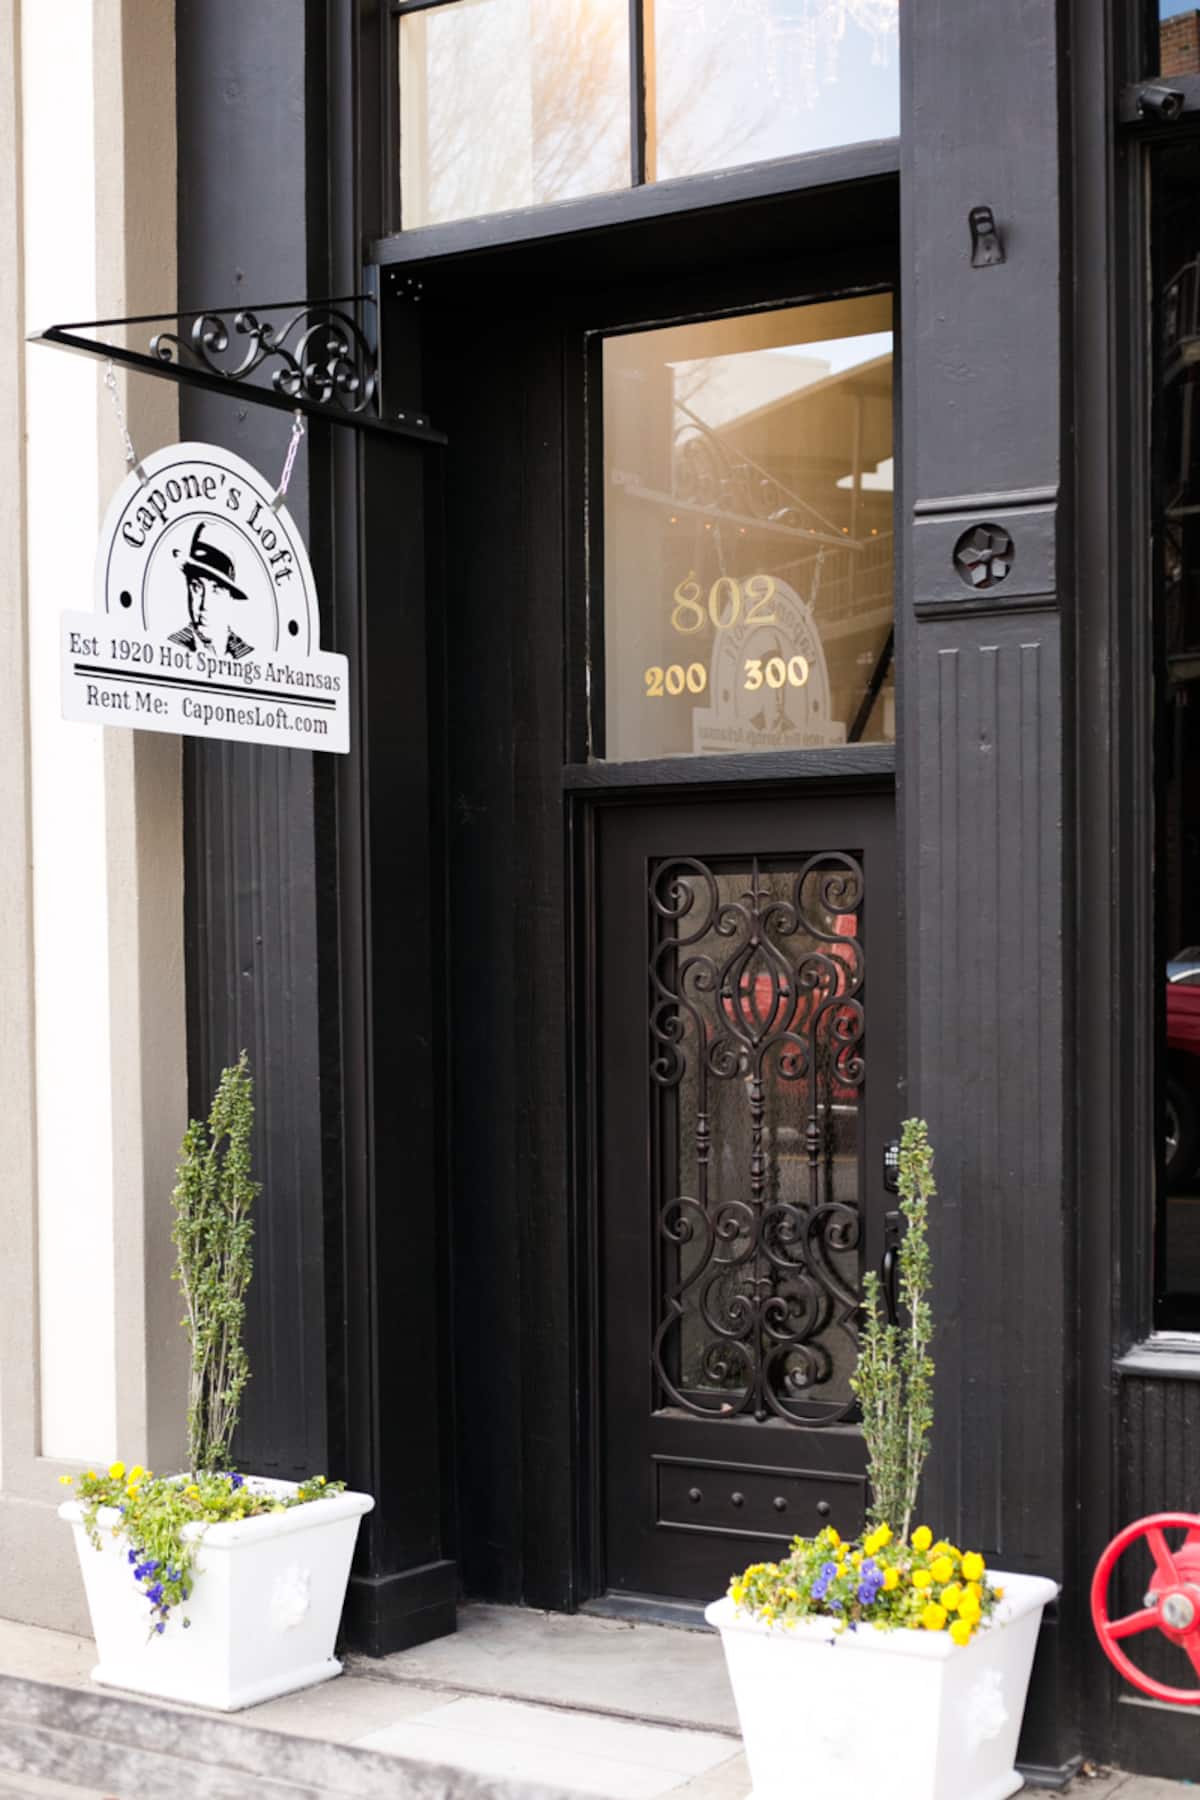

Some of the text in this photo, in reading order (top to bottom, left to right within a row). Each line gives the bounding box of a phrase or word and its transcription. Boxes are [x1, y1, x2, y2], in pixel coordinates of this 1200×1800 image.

[122, 473, 293, 587] Capone's Loft
[671, 573, 777, 633] 802
[69, 632, 341, 692] Est 1920 Hot Springs Arkansas
[644, 663, 707, 696] 200
[743, 656, 809, 691] 300
[86, 684, 328, 735] Rent Me: CaponesLoft.com
